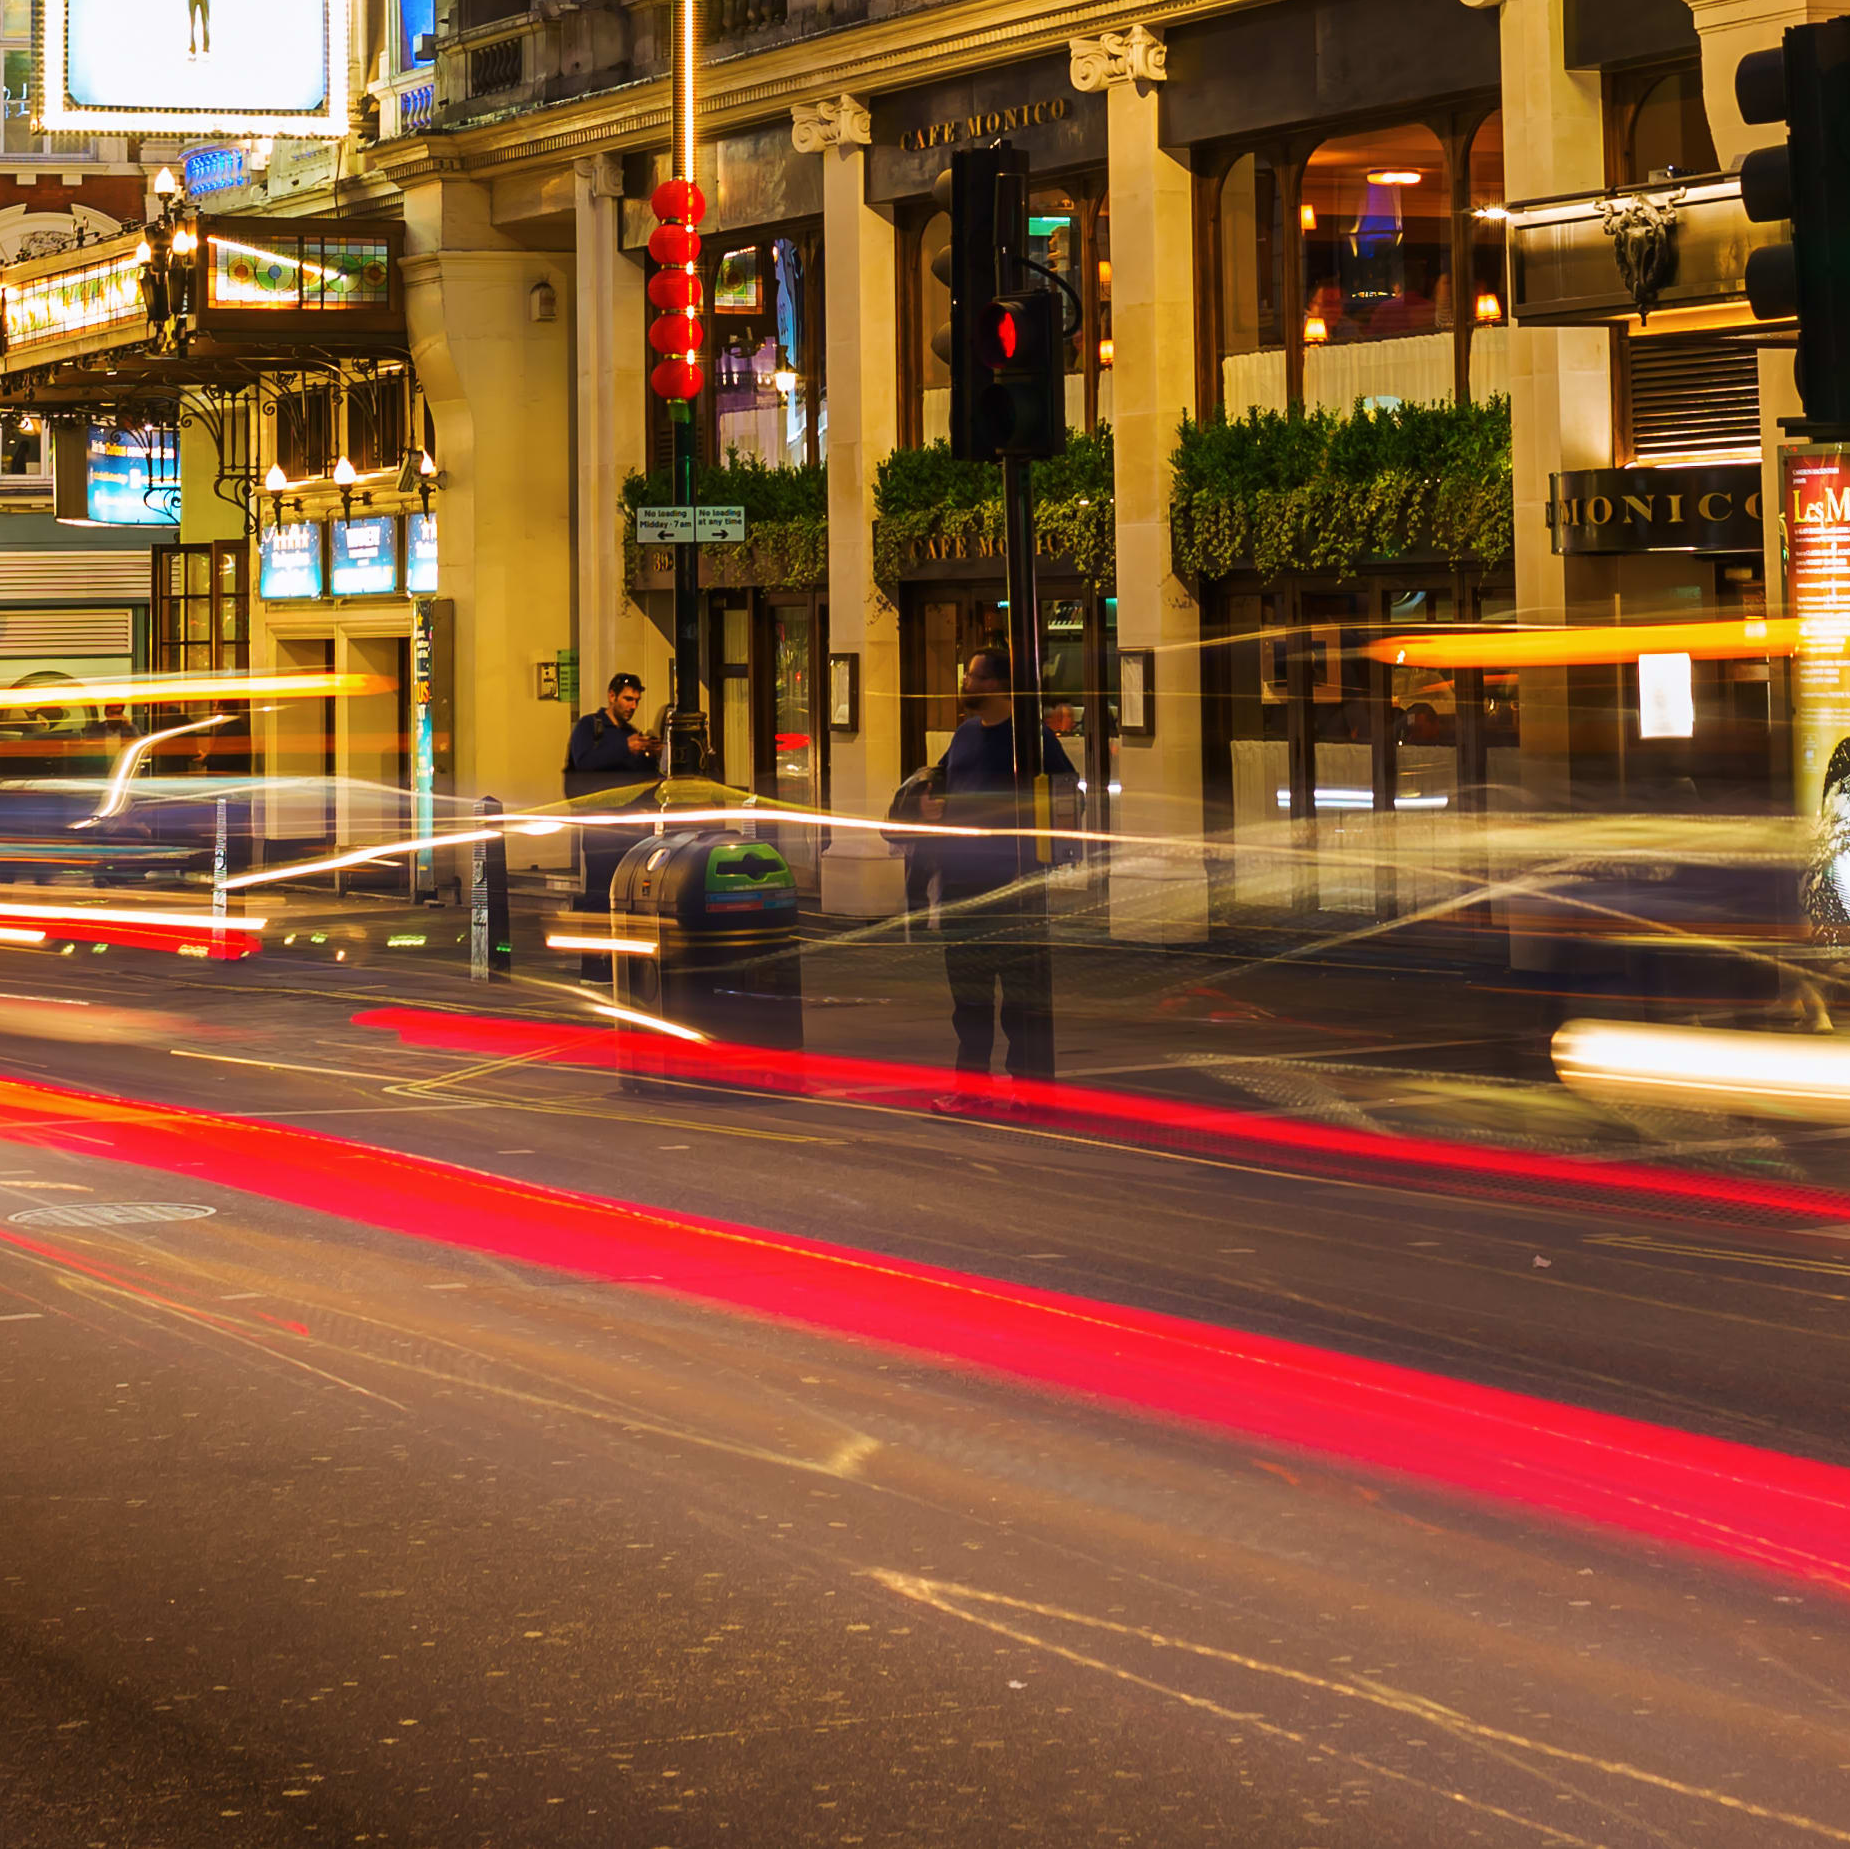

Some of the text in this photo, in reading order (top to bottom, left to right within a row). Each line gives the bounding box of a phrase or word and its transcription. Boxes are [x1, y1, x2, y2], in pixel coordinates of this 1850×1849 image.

[901, 97, 1065, 151] CAFE MONICO
[1793, 489, 1825, 523] Les
[644, 509, 688, 519] No loading
[699, 508, 742, 518] No loading
[639, 520, 668, 529] Midday
